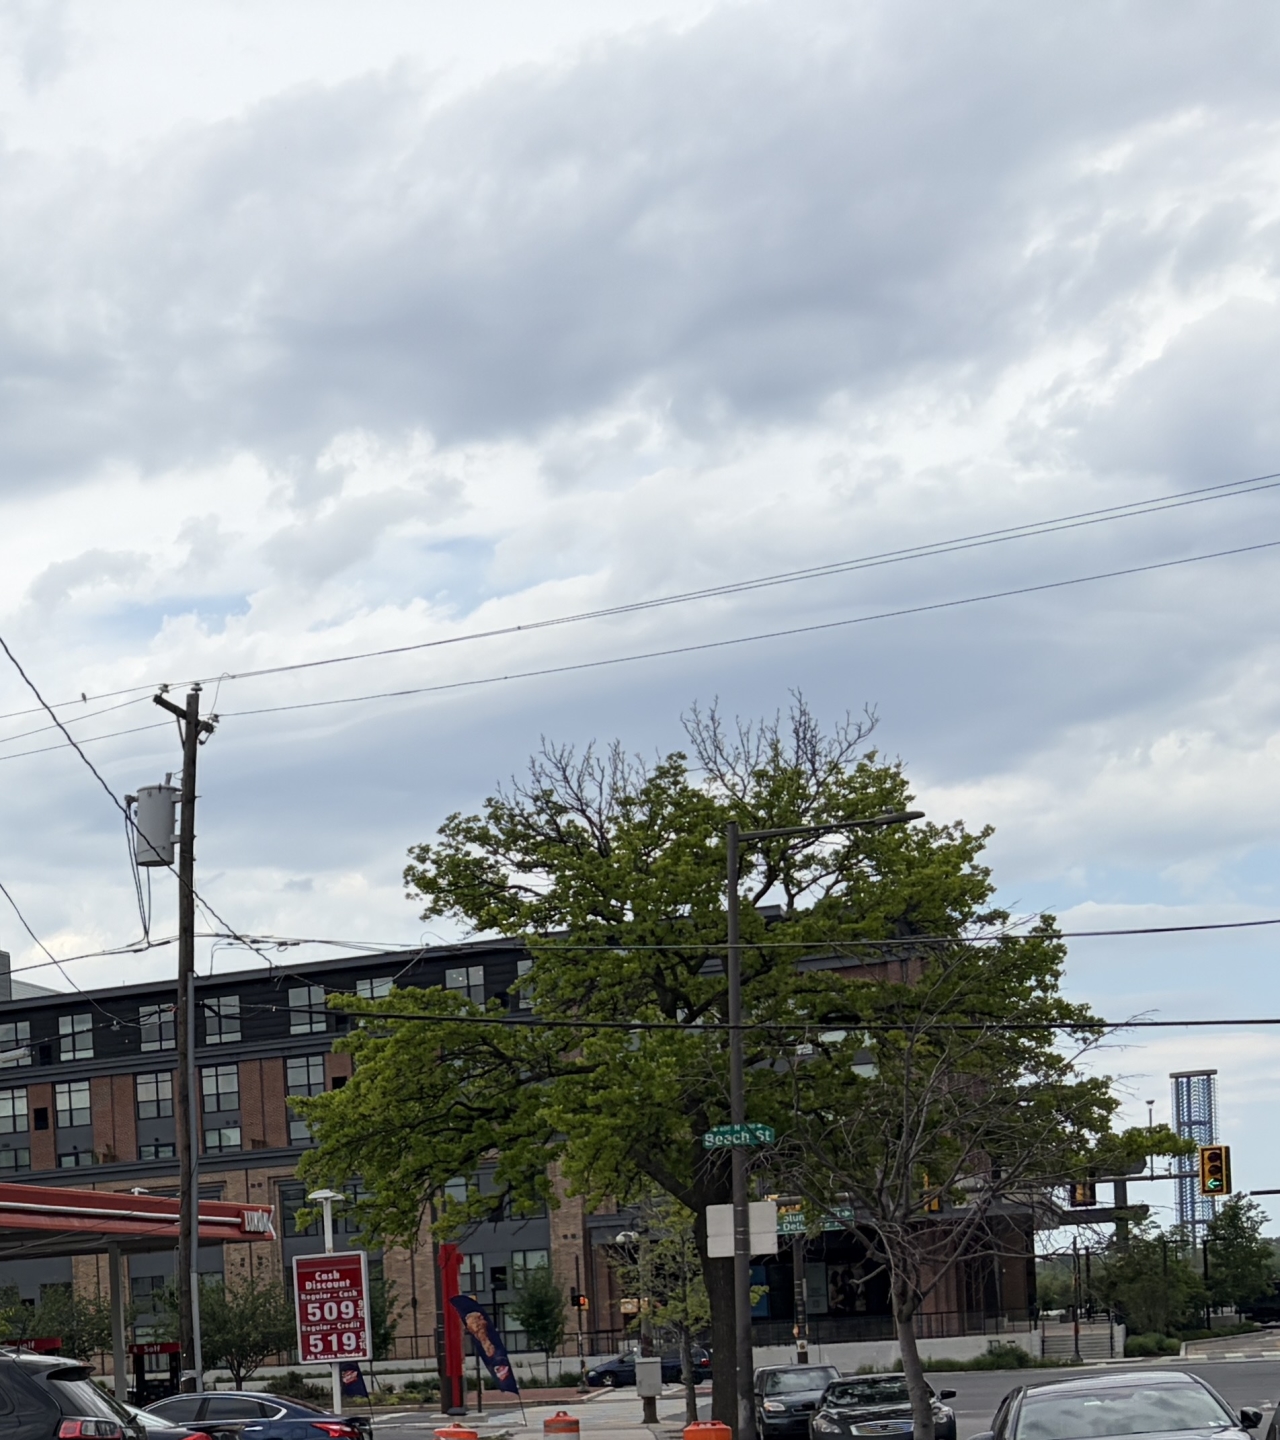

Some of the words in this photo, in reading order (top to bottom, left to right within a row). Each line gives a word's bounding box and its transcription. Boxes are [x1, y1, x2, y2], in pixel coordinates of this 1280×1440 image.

[705, 1132, 749, 1146] Beach
[756, 1130, 771, 1142] St
[315, 1270, 340, 1280] Cash
[305, 1279, 350, 1290] Discount
[308, 1301, 354, 1321] 509
[310, 1332, 356, 1352] 519
